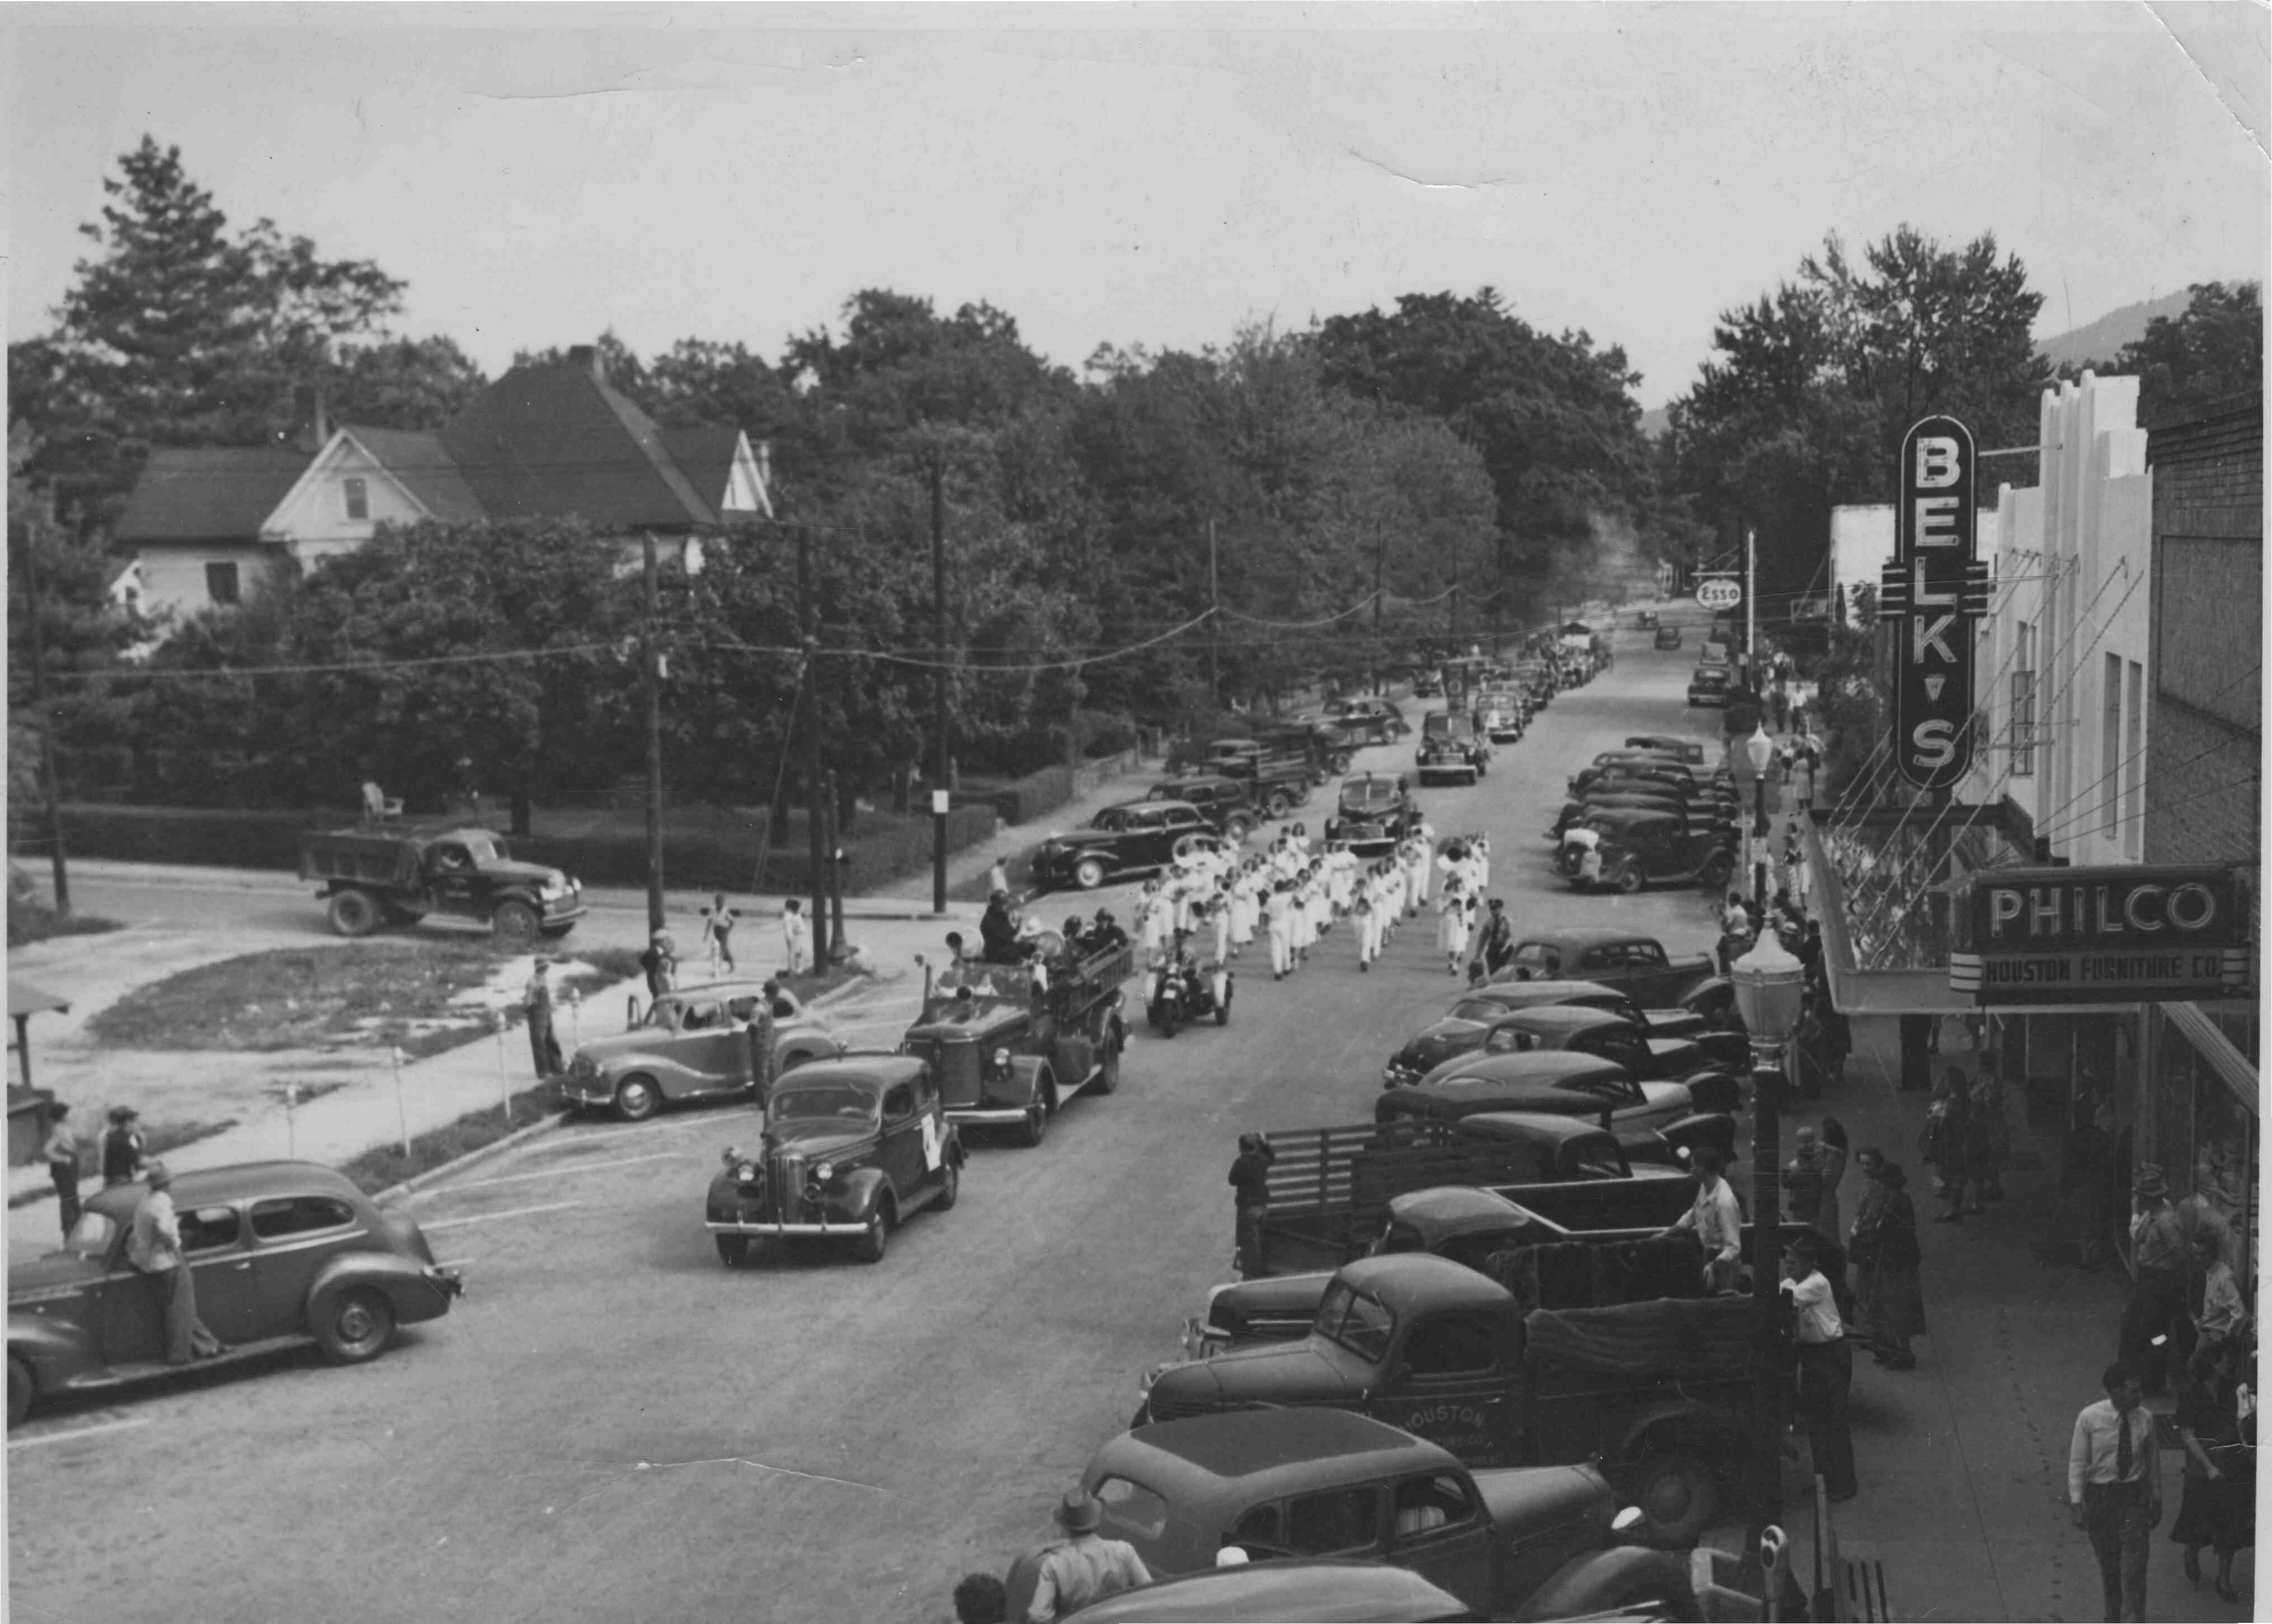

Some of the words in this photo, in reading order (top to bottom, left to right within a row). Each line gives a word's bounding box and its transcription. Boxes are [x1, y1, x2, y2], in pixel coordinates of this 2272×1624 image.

[1991, 883, 2215, 938] PHILCO
[1986, 960, 2071, 983] HOUSTON
[2081, 956, 2181, 981] FURNITURE
